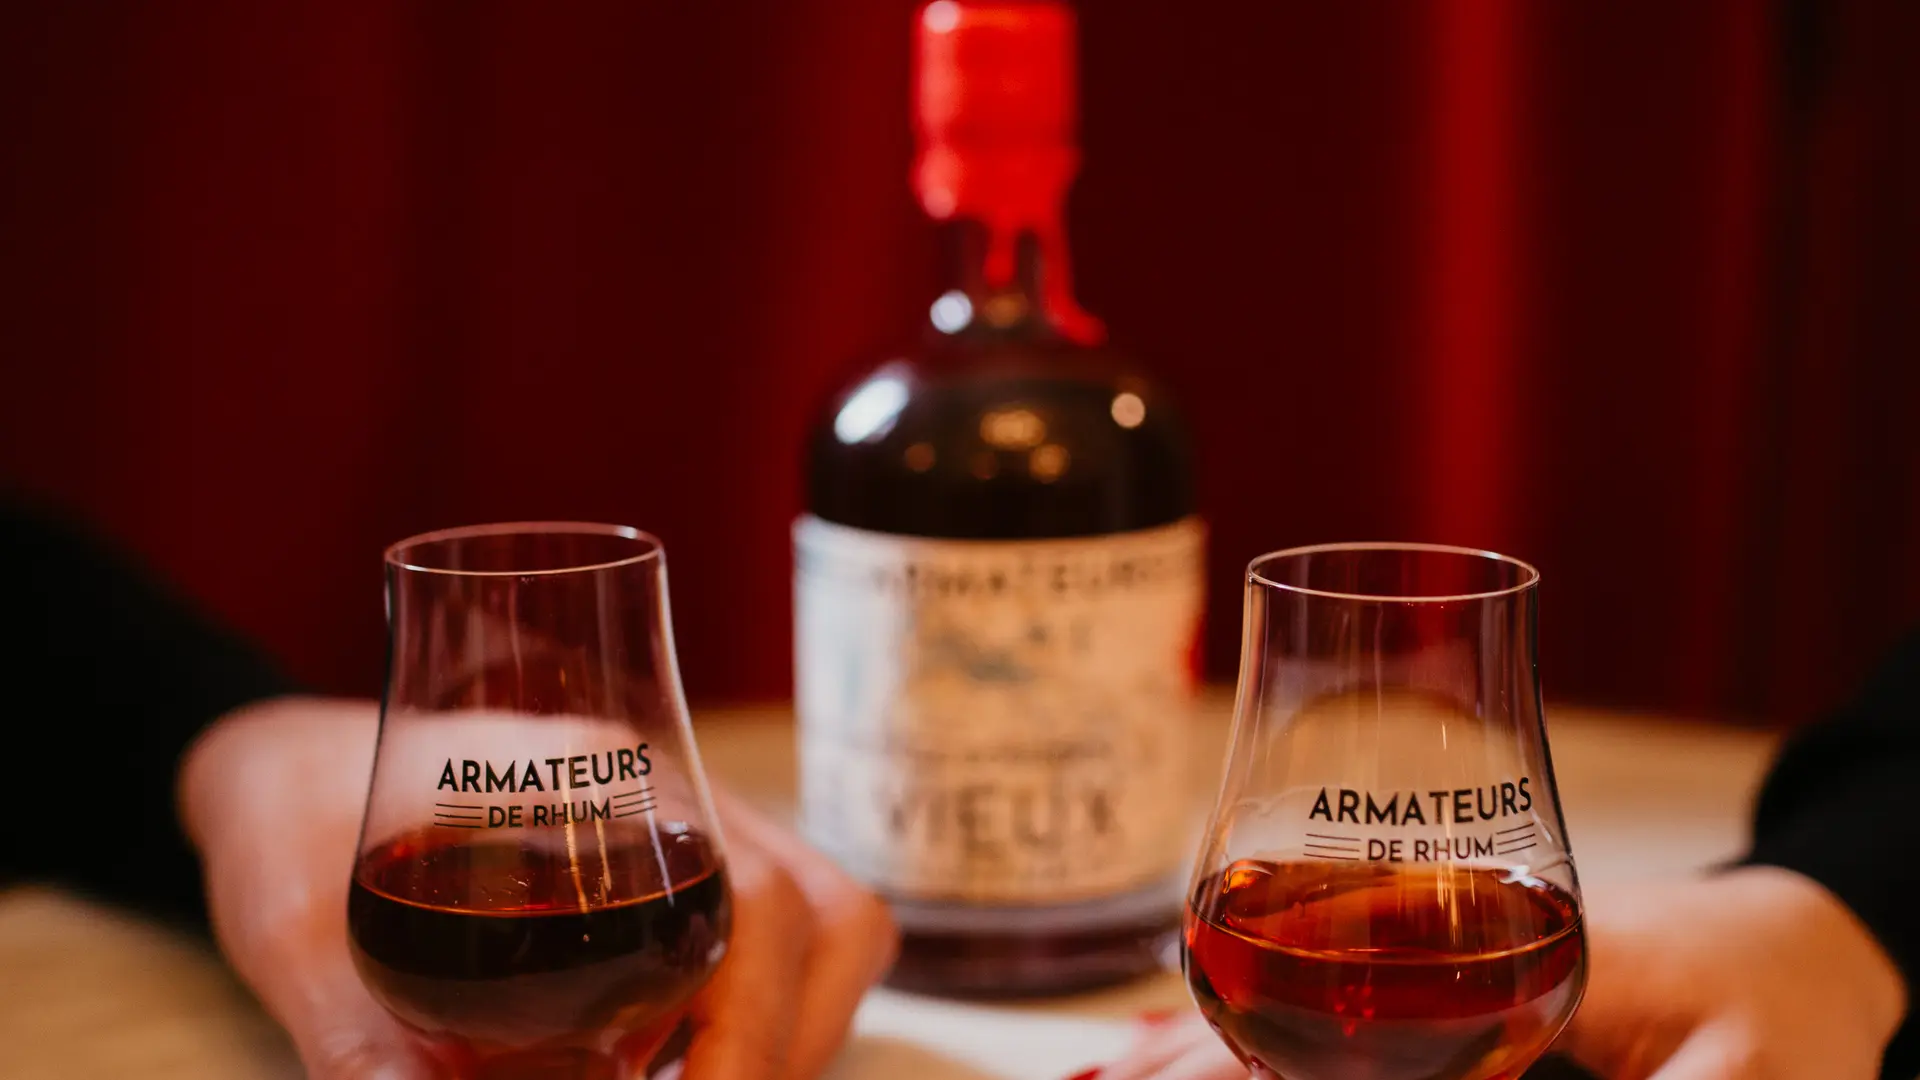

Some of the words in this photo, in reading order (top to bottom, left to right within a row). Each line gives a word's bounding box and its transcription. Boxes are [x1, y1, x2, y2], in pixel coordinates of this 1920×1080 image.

[437, 743, 652, 792] ARMATEURS
[488, 806, 523, 828] DE
[534, 798, 611, 826] RHUM
[1309, 777, 1531, 826] ARMATEURS
[1368, 839, 1403, 863] DE
[1414, 834, 1493, 862] RHUM
